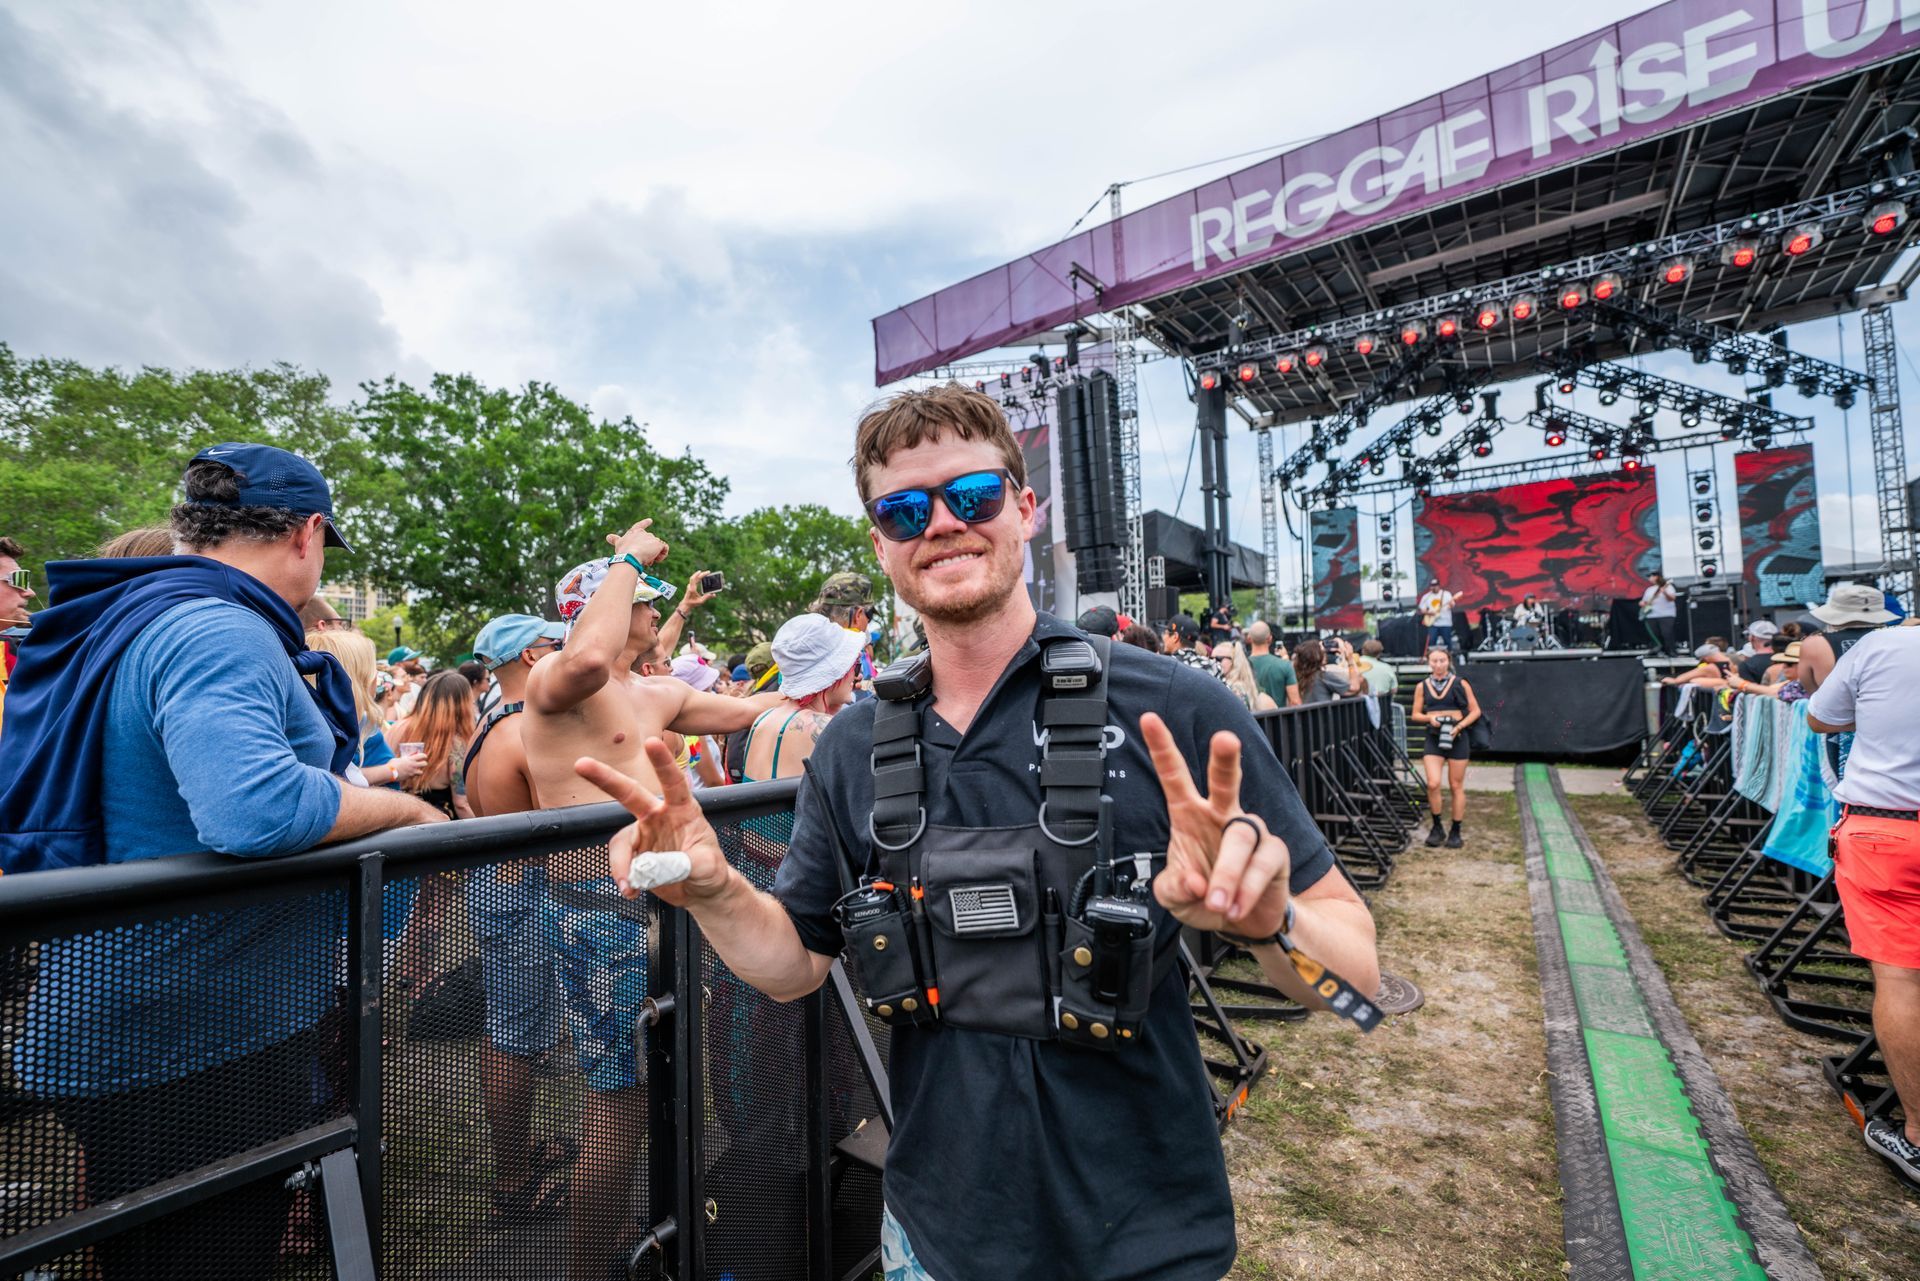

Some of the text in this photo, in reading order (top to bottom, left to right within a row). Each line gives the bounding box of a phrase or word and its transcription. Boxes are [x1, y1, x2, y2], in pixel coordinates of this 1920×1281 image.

[1190, 109, 1490, 272] REGGAE
[1528, 9, 1758, 159] RISE
[854, 908, 881, 918] KENWOOD
[1095, 902, 1138, 914] MOTOROLA
